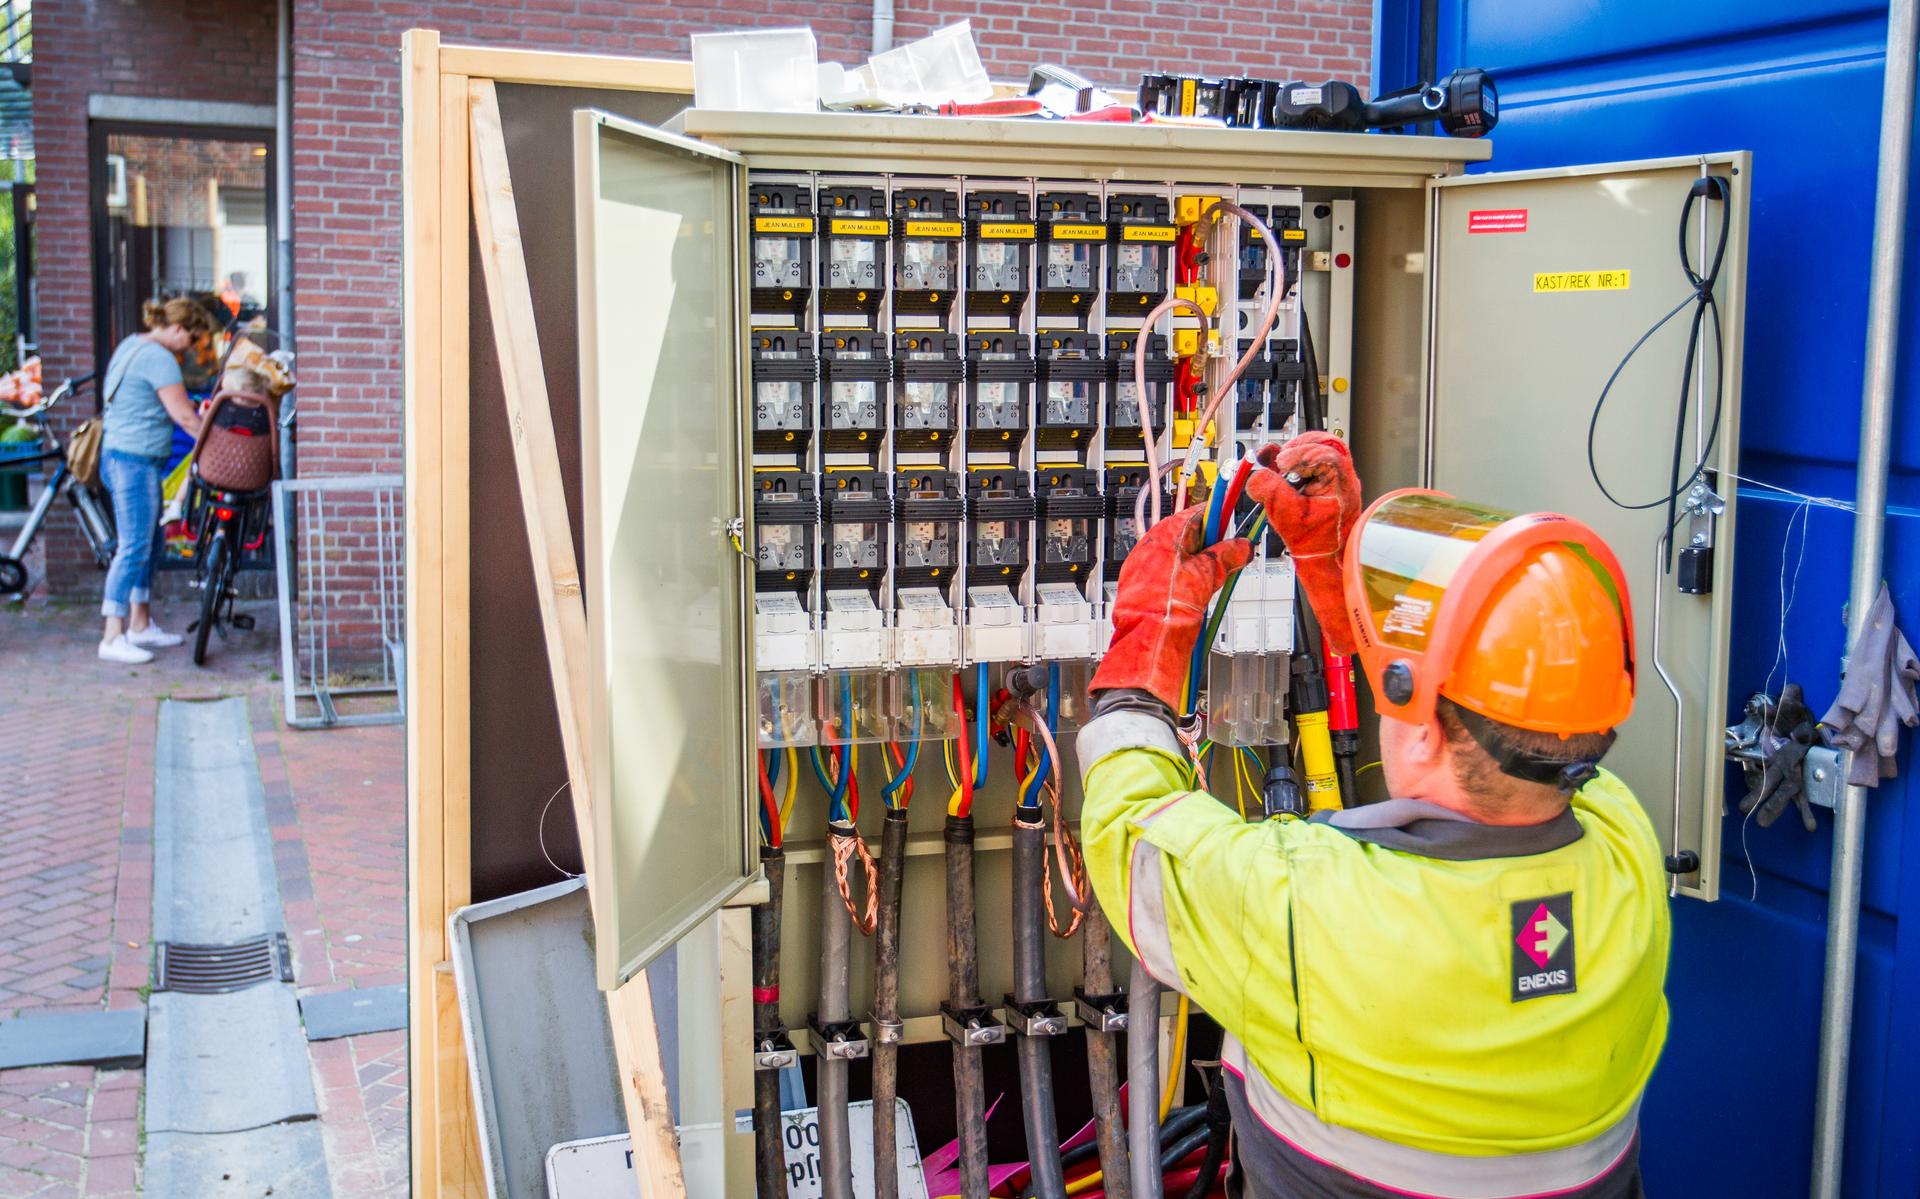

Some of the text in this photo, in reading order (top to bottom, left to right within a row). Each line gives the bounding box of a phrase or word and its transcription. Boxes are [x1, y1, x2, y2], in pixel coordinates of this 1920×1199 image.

[1535, 273, 1627, 289] KAST/REK NR:1
[1518, 969, 1568, 992] ENEXIS
